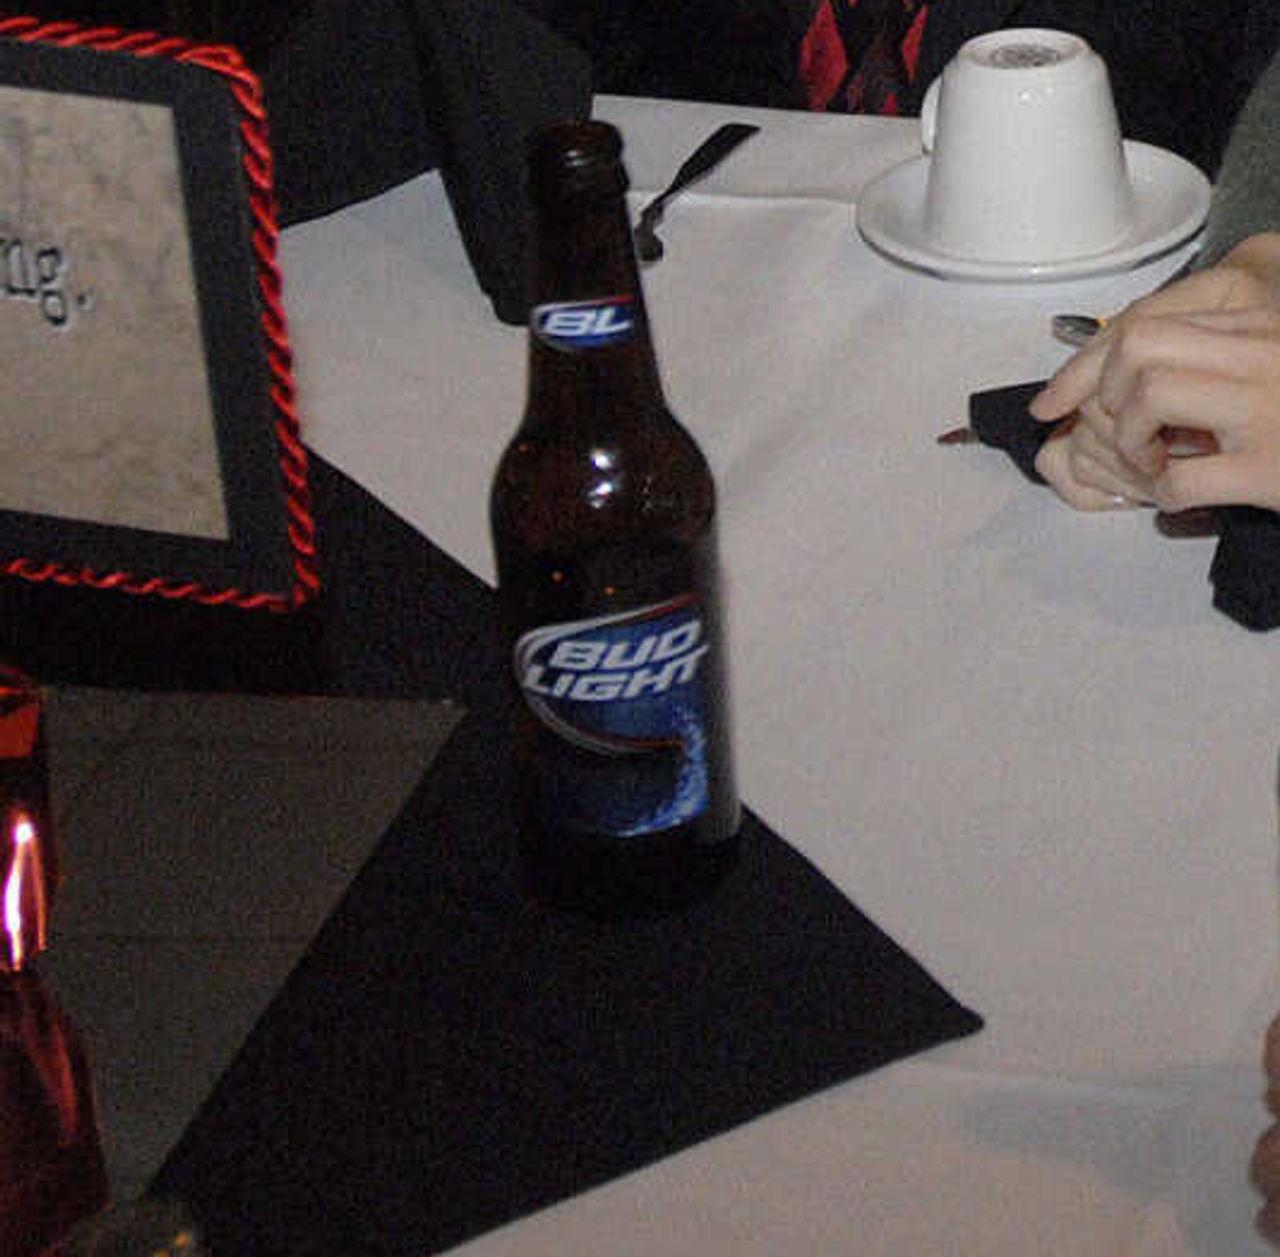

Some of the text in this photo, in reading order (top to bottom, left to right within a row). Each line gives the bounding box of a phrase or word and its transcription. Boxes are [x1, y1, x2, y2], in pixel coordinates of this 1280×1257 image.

[543, 308, 632, 337] BL
[550, 620, 700, 670] BUD
[522, 645, 709, 701] LIGHT
